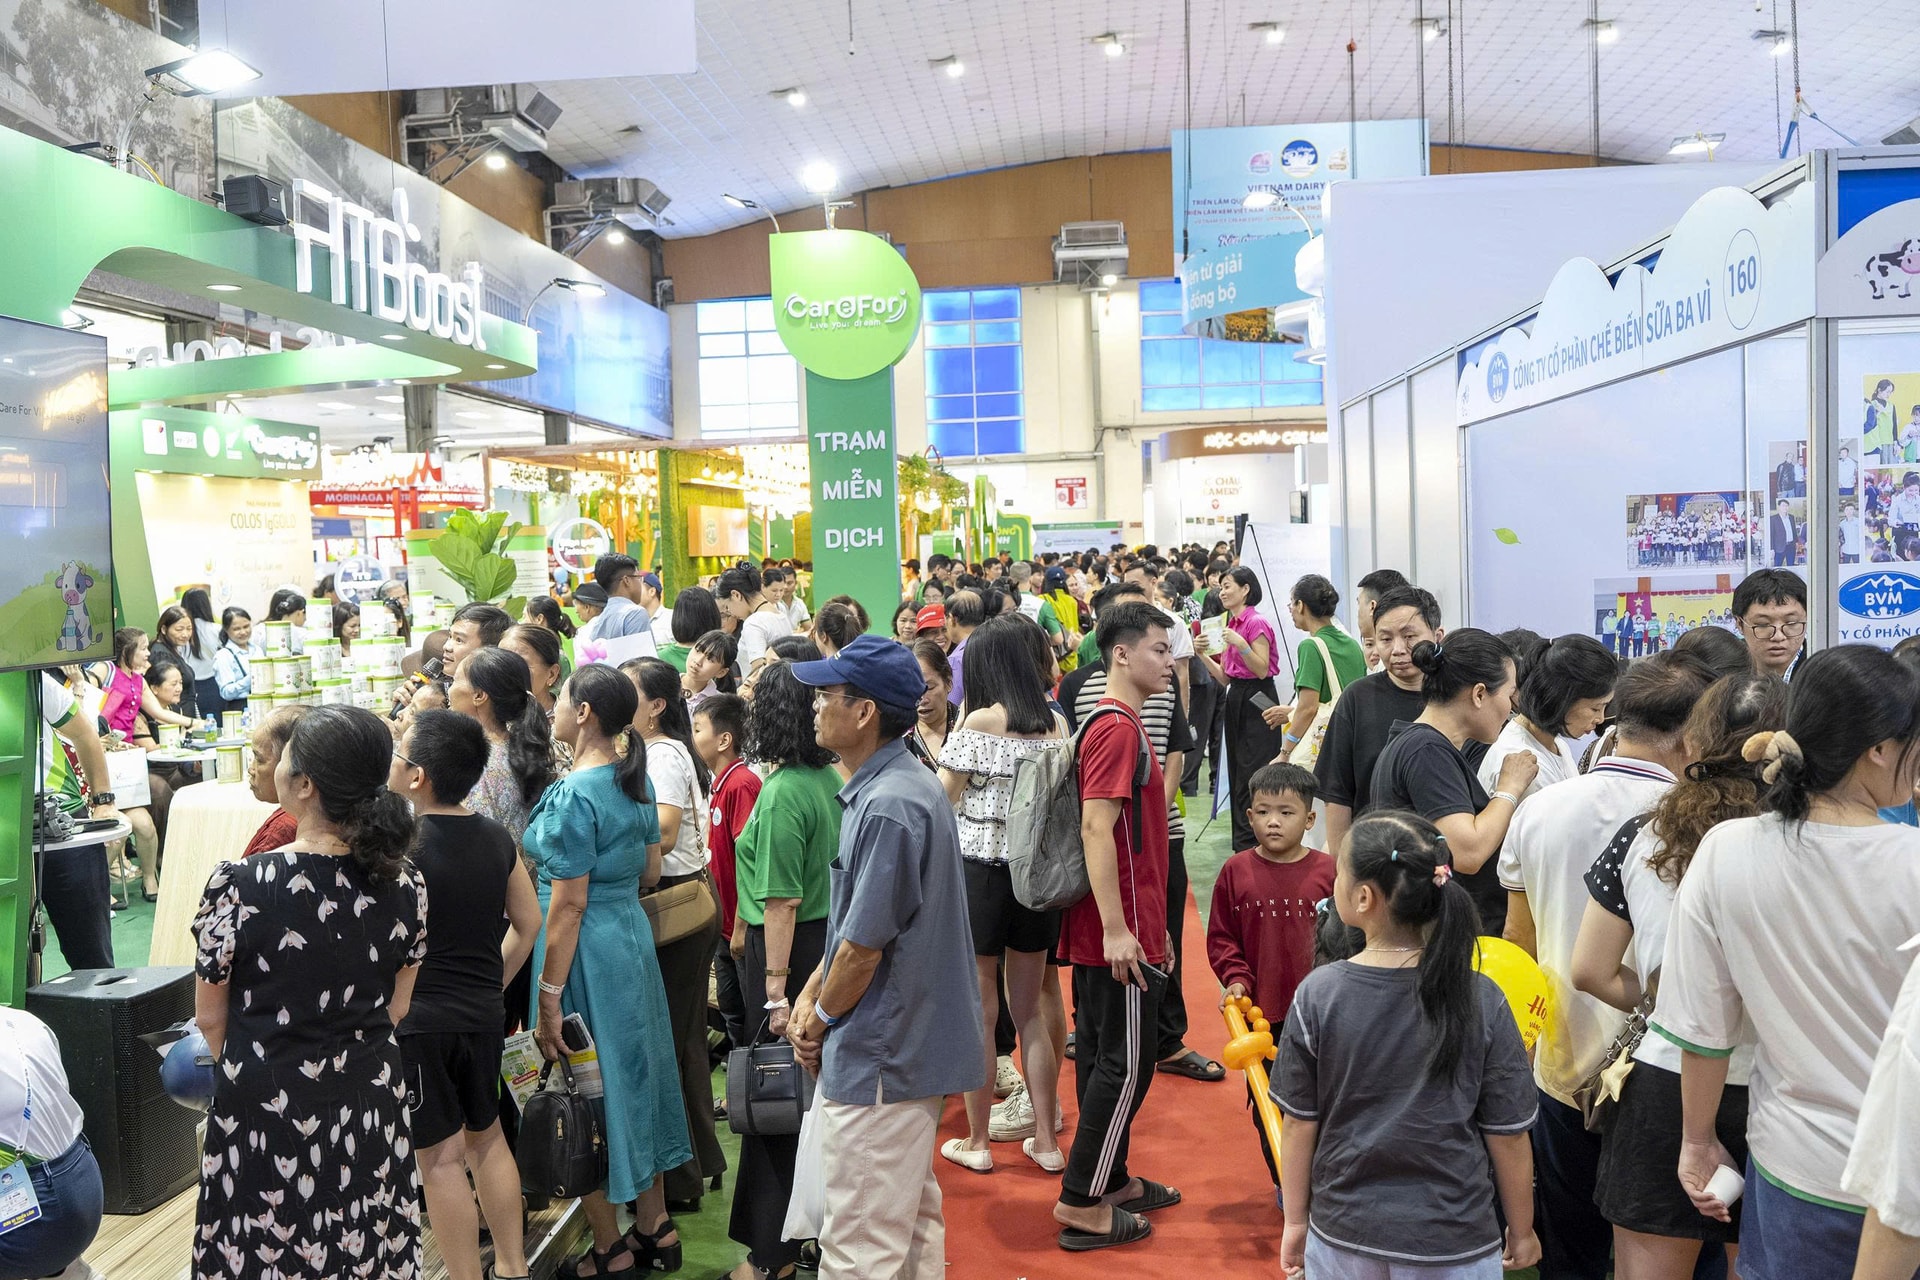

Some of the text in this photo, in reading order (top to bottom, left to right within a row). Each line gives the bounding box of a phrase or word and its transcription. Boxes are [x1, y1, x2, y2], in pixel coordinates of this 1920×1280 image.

[1295, 182, 1326, 191] DAIRY
[1728, 255, 1757, 297] 160
[810, 321, 828, 330] Live
[854, 319, 881, 328] dream
[1513, 278, 1712, 390] CÔNG TY CỔ PHẦN CHẾ BIẾN SỮA BA VÌ
[18, 404, 31, 416] For
[814, 429, 886, 455] TRẠM
[822, 467, 882, 501] MIỄN
[325, 492, 383, 503] MORINAGA
[230, 512, 262, 529] COLOS
[825, 526, 884, 553] DỊCH
[1864, 591, 1903, 606] BVM
[1839, 629, 1849, 640] Y
[1853, 624, 1871, 639] CỔ
[1875, 623, 1911, 639] PHẦN
